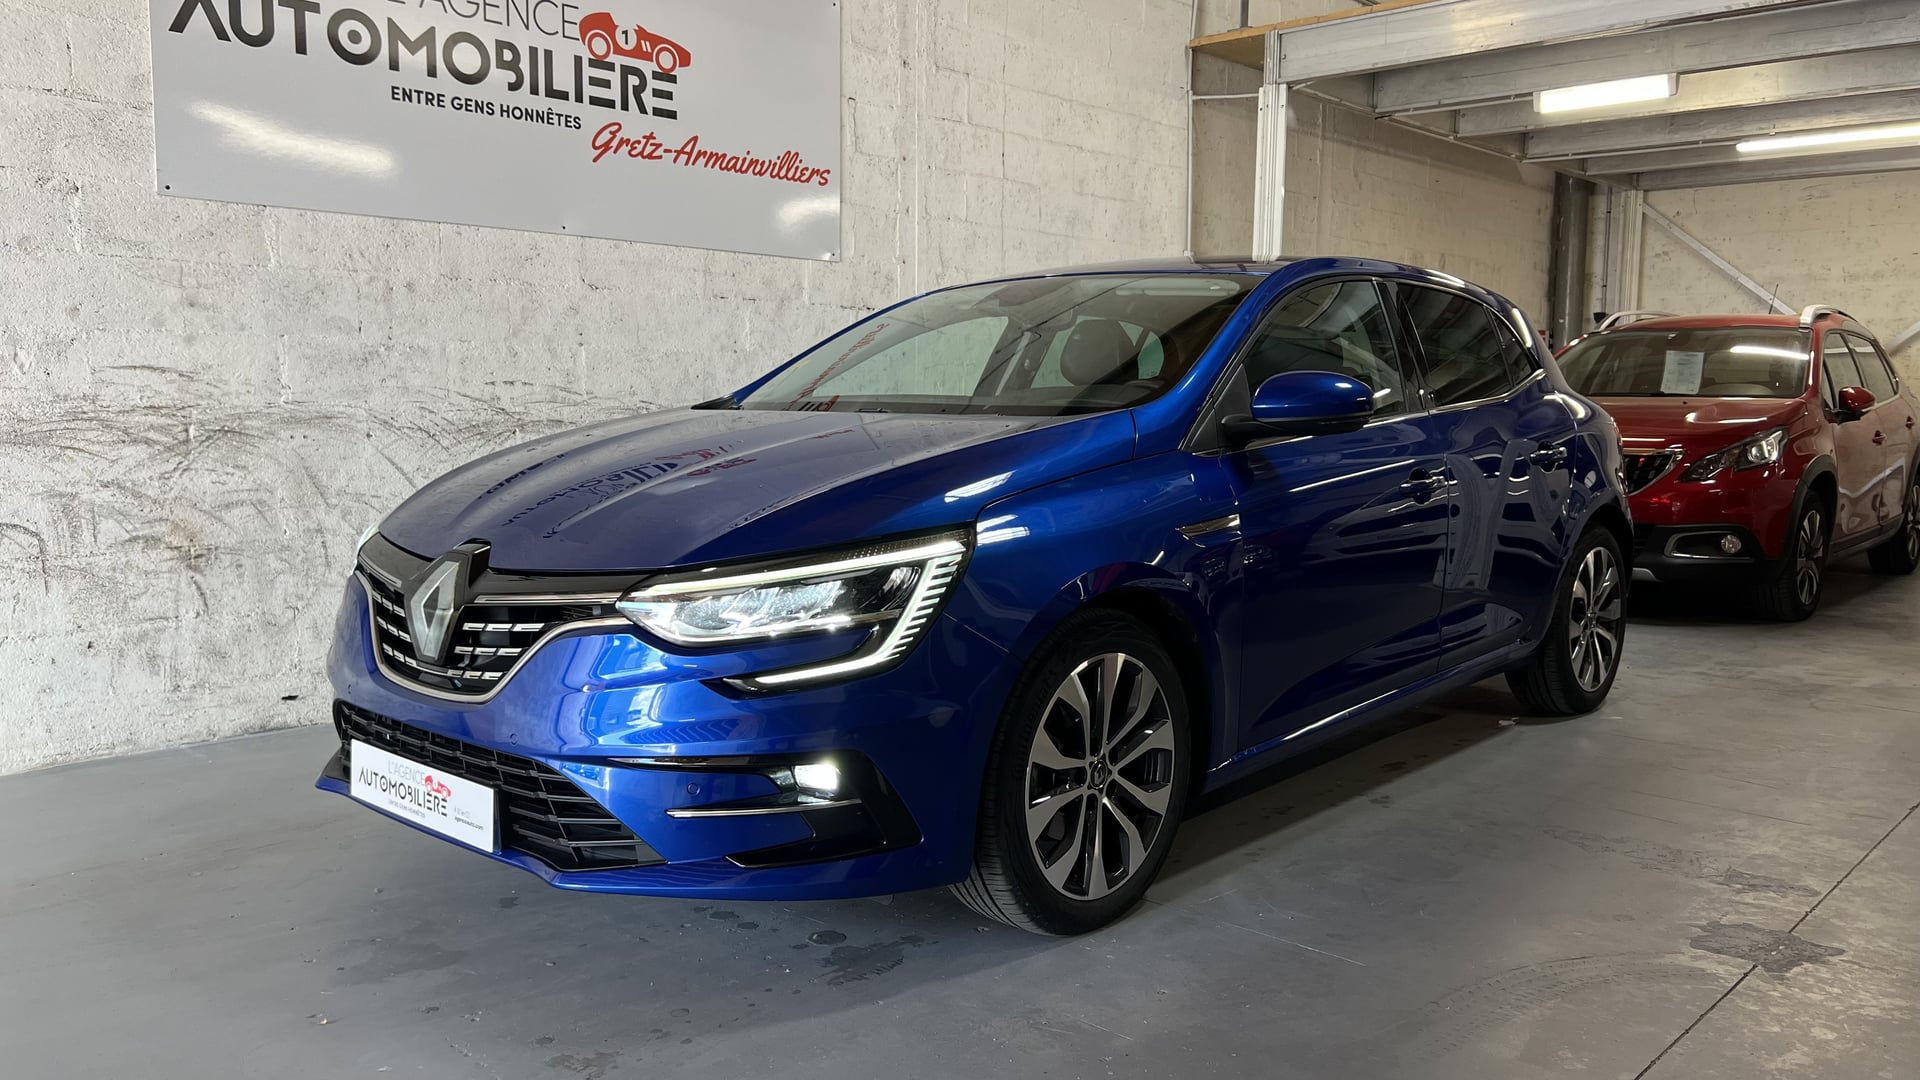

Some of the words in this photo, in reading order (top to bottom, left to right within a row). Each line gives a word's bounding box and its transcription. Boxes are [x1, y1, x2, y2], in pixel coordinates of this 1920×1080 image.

[388, 0, 580, 41] GENCE
[391, 85, 446, 109] ENTRE
[451, 96, 496, 117] GENS
[500, 104, 582, 130] HONNÊTES
[592, 121, 832, 187] Gretz-Armainvilliers
